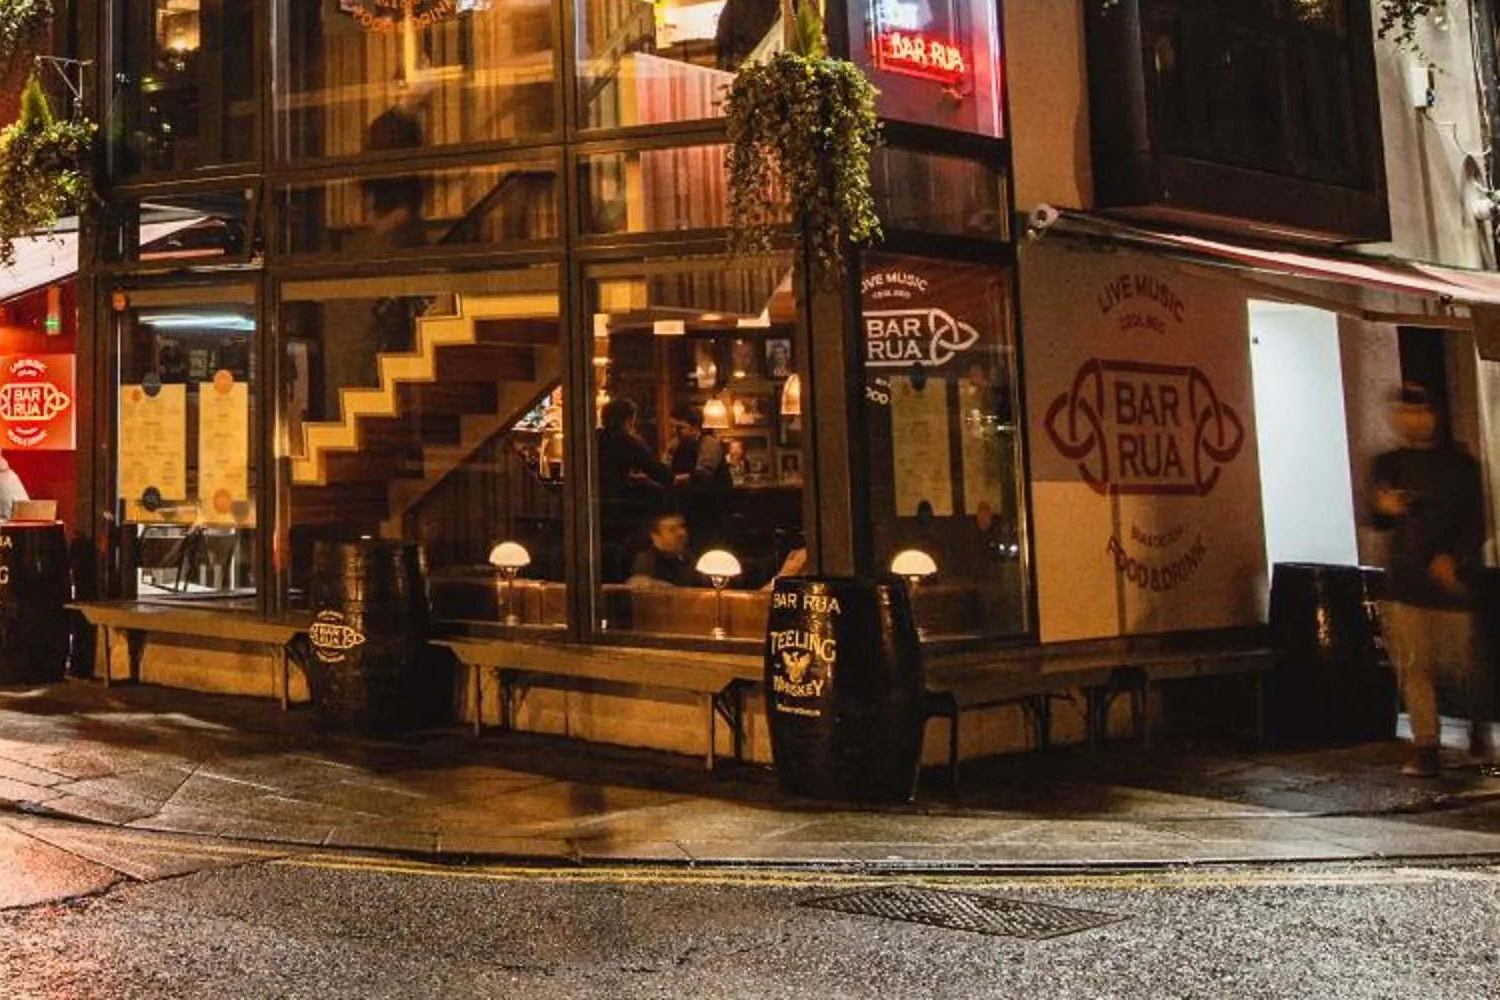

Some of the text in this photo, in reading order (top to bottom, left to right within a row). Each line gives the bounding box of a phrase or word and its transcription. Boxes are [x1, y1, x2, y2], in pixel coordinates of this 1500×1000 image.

[890, 31, 965, 73] BAR RUA
[886, 271, 929, 292] MUSIC
[1097, 273, 1186, 323] LIVE MUSIC
[866, 318, 922, 339] BAR
[867, 339, 923, 359] RUA
[13, 388, 41, 401] BAR
[1115, 380, 1181, 427] BAR
[13, 402, 42, 416] RUA
[1118, 433, 1186, 478] RUA
[1106, 536, 1149, 589] FOOD
[1150, 567, 1161, 592] &
[773, 592, 841, 615] BAR RUA
[770, 629, 837, 662] TEELING
[773, 675, 825, 697] WHISKEY
